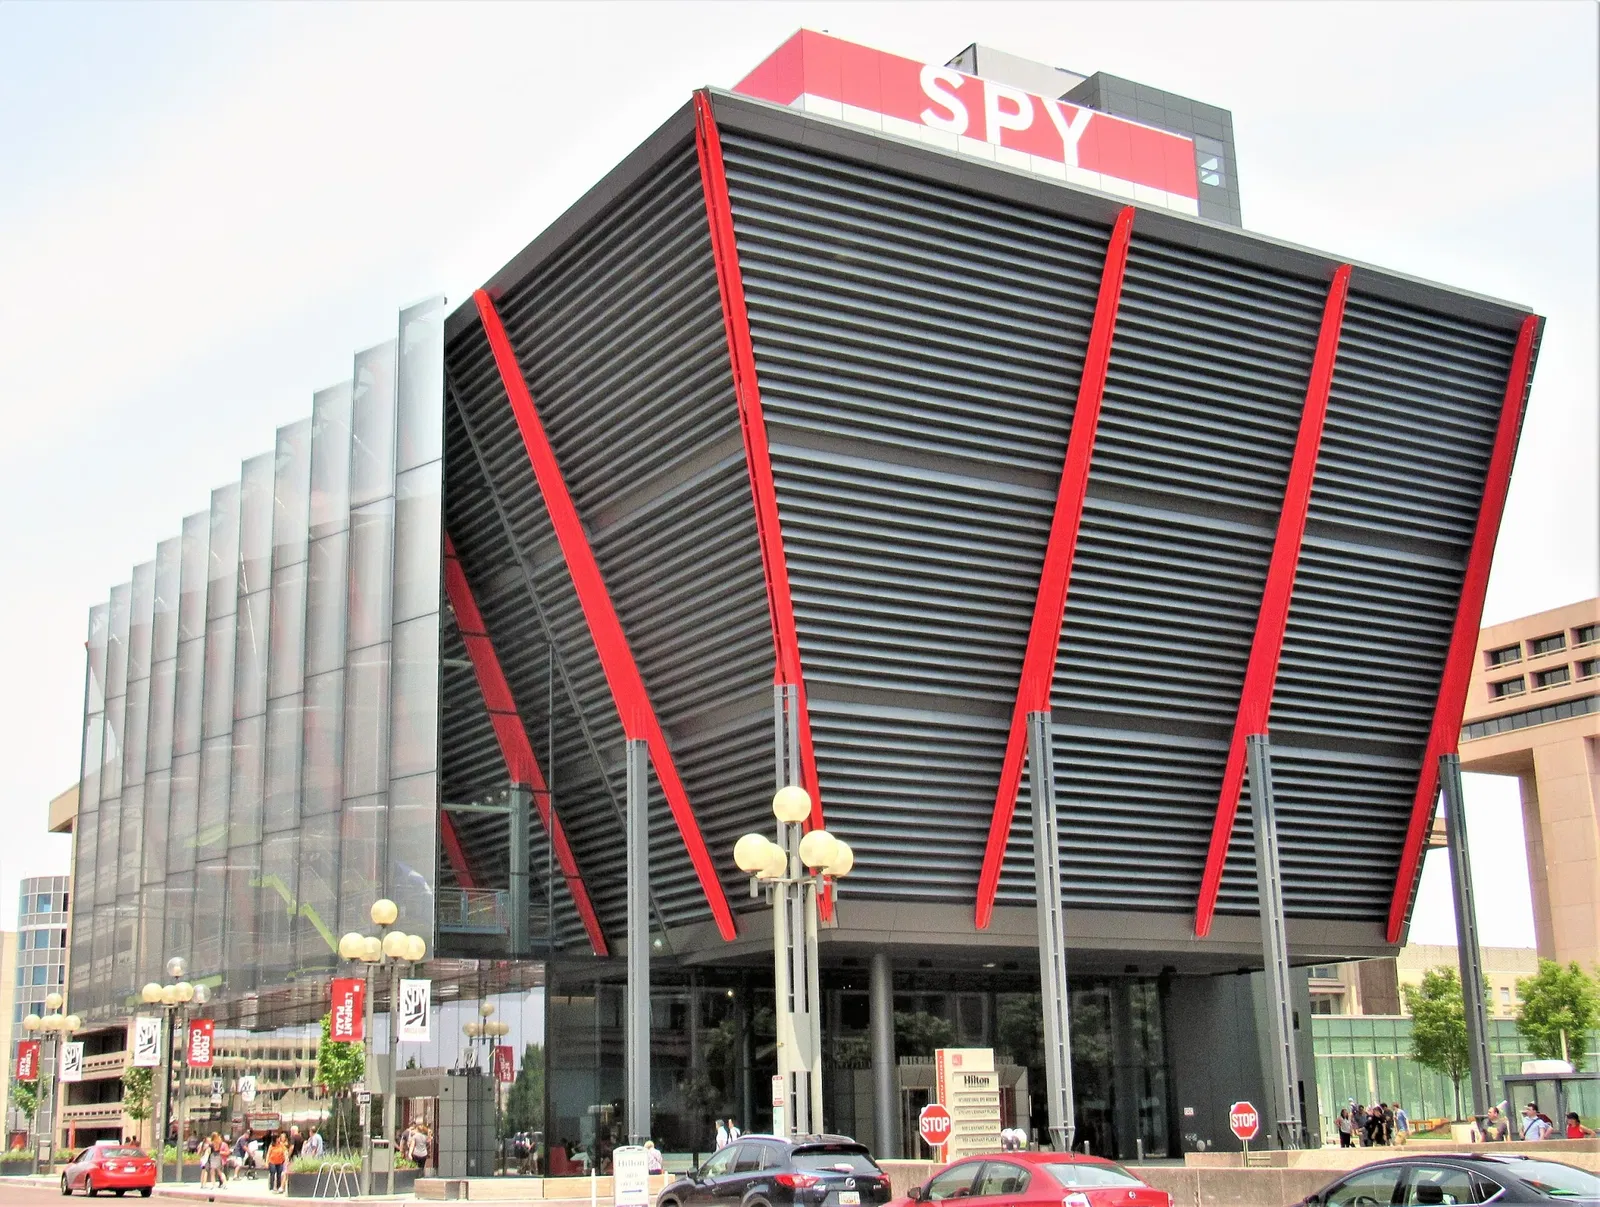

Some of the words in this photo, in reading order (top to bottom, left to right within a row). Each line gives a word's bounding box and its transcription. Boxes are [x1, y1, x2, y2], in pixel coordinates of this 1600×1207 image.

[919, 64, 1094, 168] SPY
[336, 1006, 346, 1037] PLAZA
[345, 992, 354, 1036] L'ENFANT
[404, 988, 427, 1026] SPY
[138, 1024, 158, 1054] SPY
[192, 1029, 203, 1063] COURT
[201, 1035, 211, 1063] FOOD
[64, 1047, 81, 1071] SPY
[964, 1075, 990, 1085] Hilton
[922, 1117, 951, 1133] STOP
[1231, 1113, 1256, 1128] STOP
